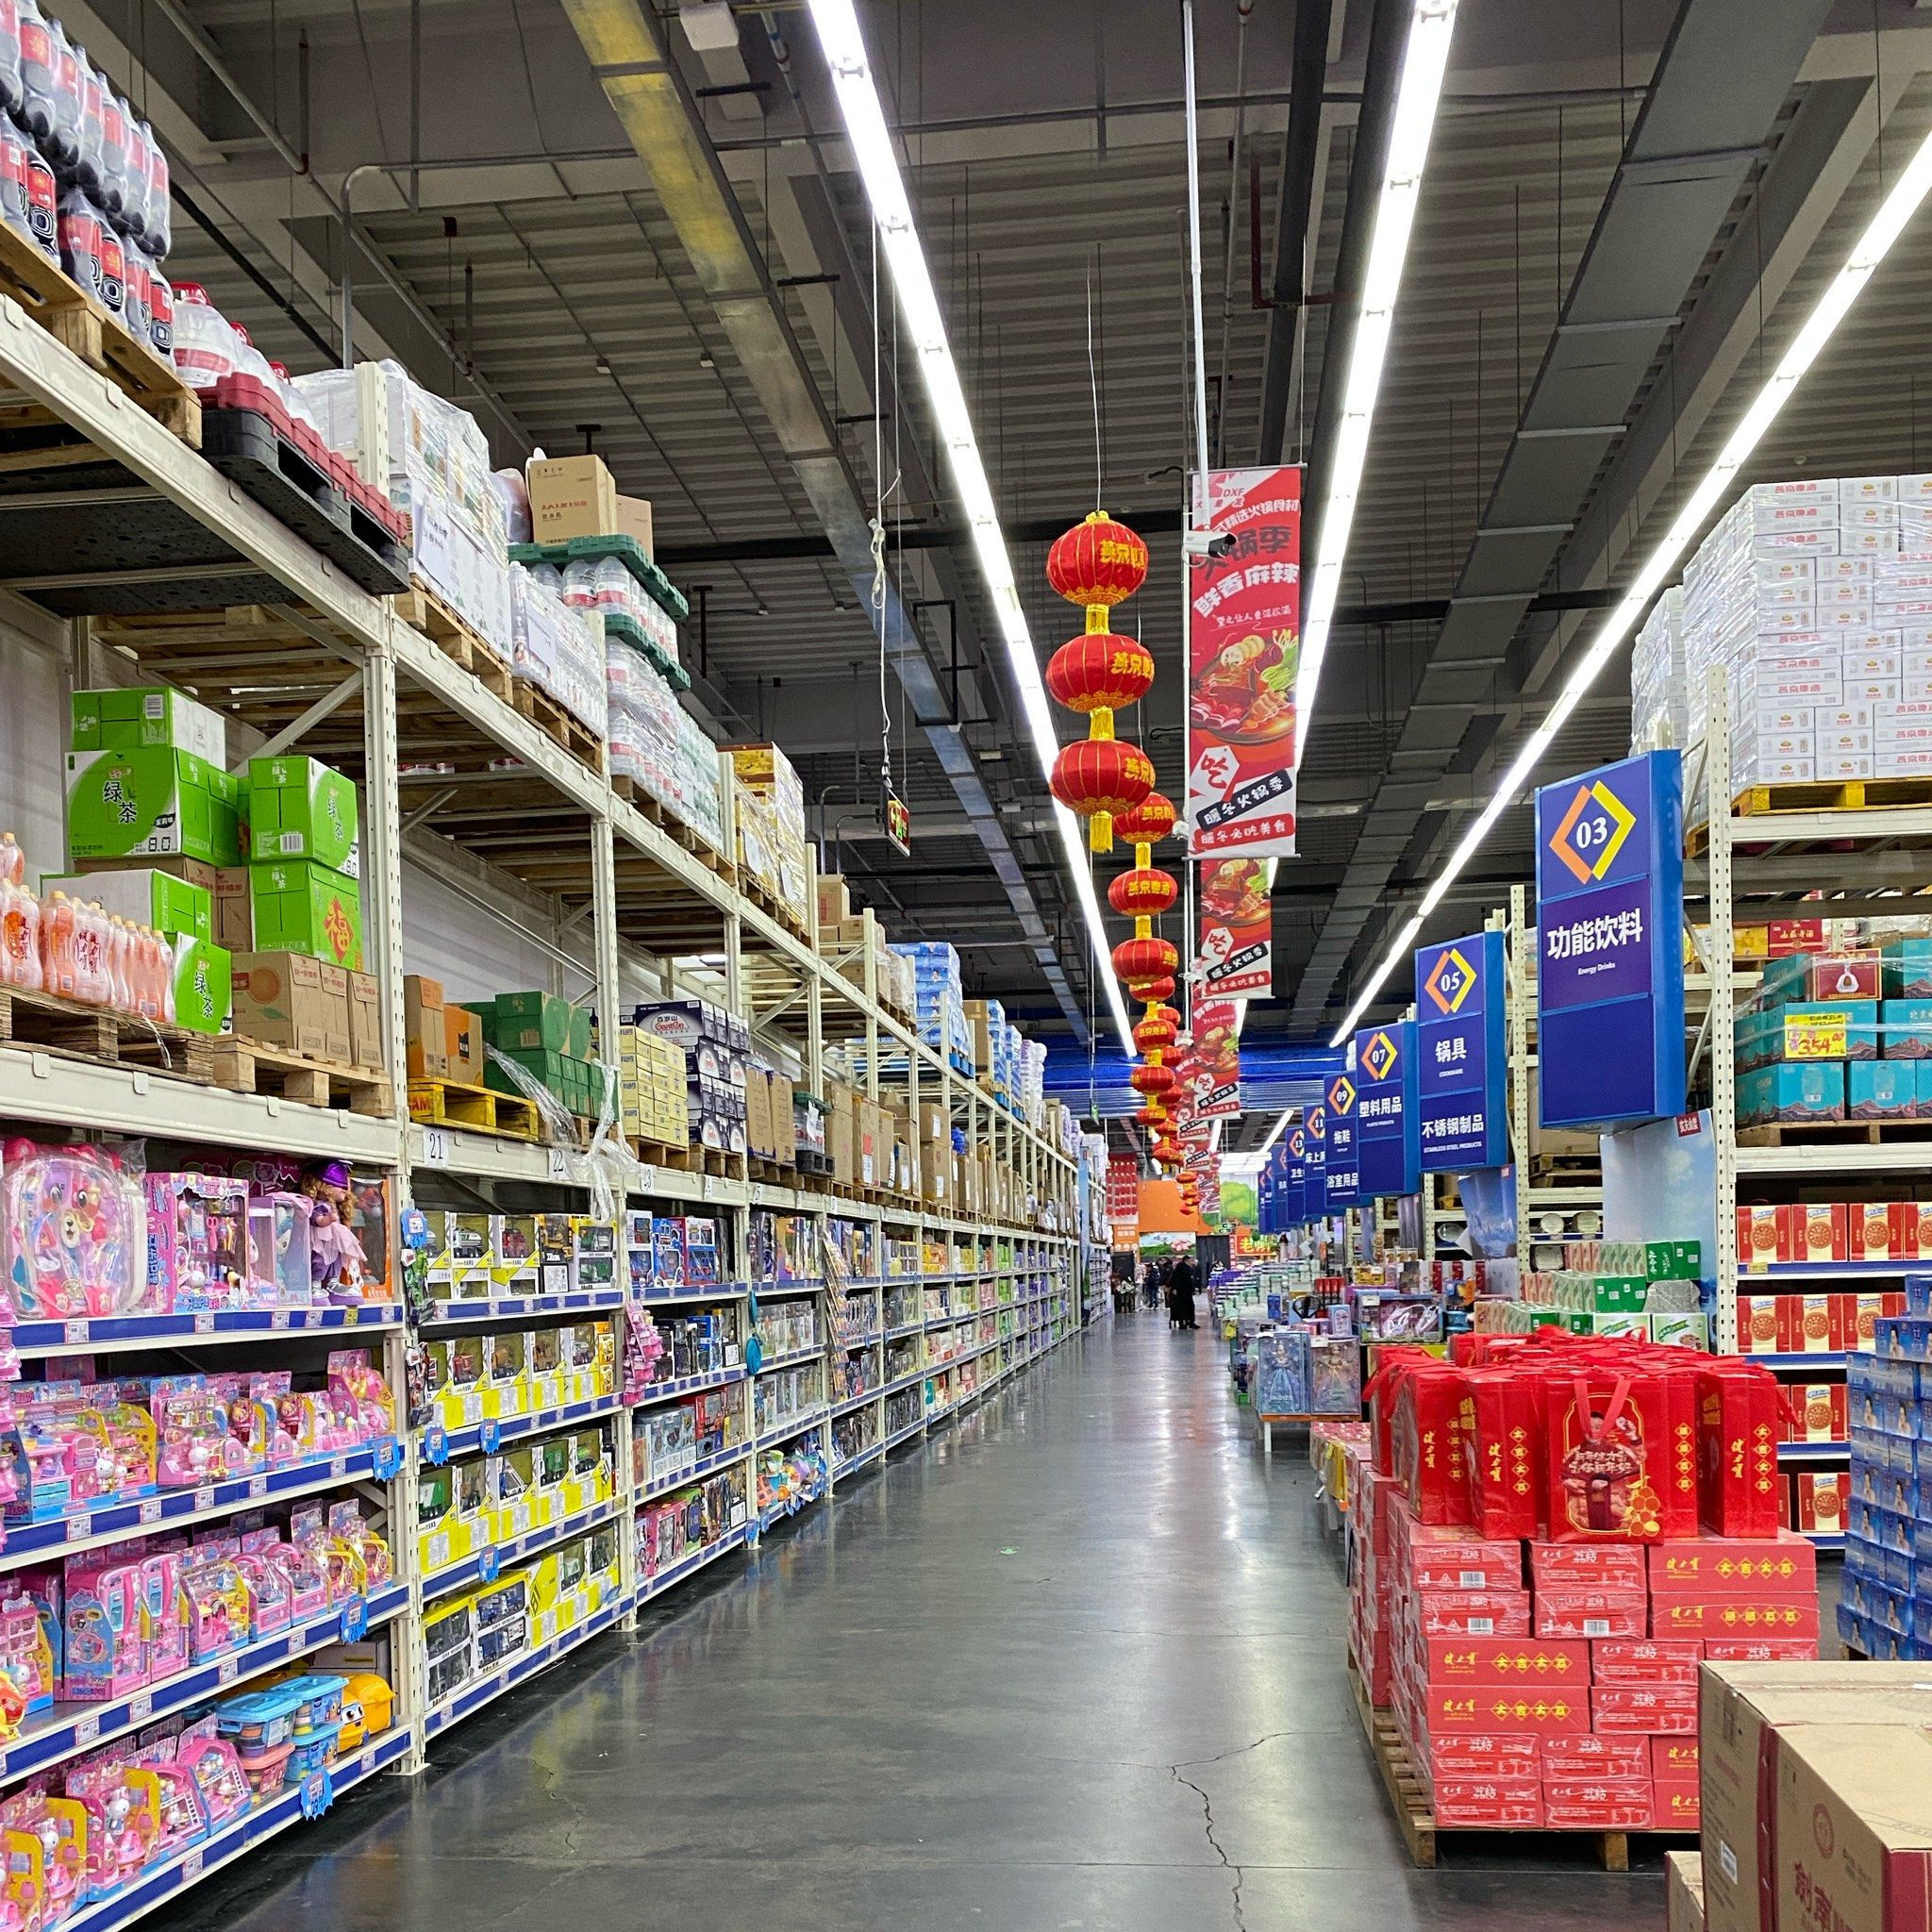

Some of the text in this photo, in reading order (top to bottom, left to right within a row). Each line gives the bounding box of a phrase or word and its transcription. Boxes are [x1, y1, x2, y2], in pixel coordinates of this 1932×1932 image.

[1224, 488, 1244, 497] DXF
[1192, 561, 1300, 618] 鲜香麻辣
[104, 781, 138, 824] 绿茶
[1204, 775, 1283, 824] 暖冬火锅季
[1201, 819, 1286, 844] 暖冬必吃美食
[1575, 817, 1607, 849] 03
[148, 837, 171, 852] 8.0
[1547, 907, 1643, 959] 功能饮料
[1578, 962, 1616, 975] Energy Drinks
[1441, 971, 1460, 991] 05
[194, 972, 214, 1019] 绿茶
[1372, 1049, 1386, 1064] 07
[1435, 1038, 1467, 1062] 锅具
[1798, 1038, 1832, 1055] 354
[1337, 1091, 1348, 1102] 09
[1358, 1096, 1402, 1118] 塑料用品
[1334, 1129, 1351, 1144] 拖鞋
[1422, 1113, 1484, 1139] 不锈钢制品
[429, 1133, 443, 1159] 21
[553, 1149, 564, 1172] 22
[1291, 1168, 1305, 1178] 卫生
[1326, 1173, 1358, 1188] 浴室用品
